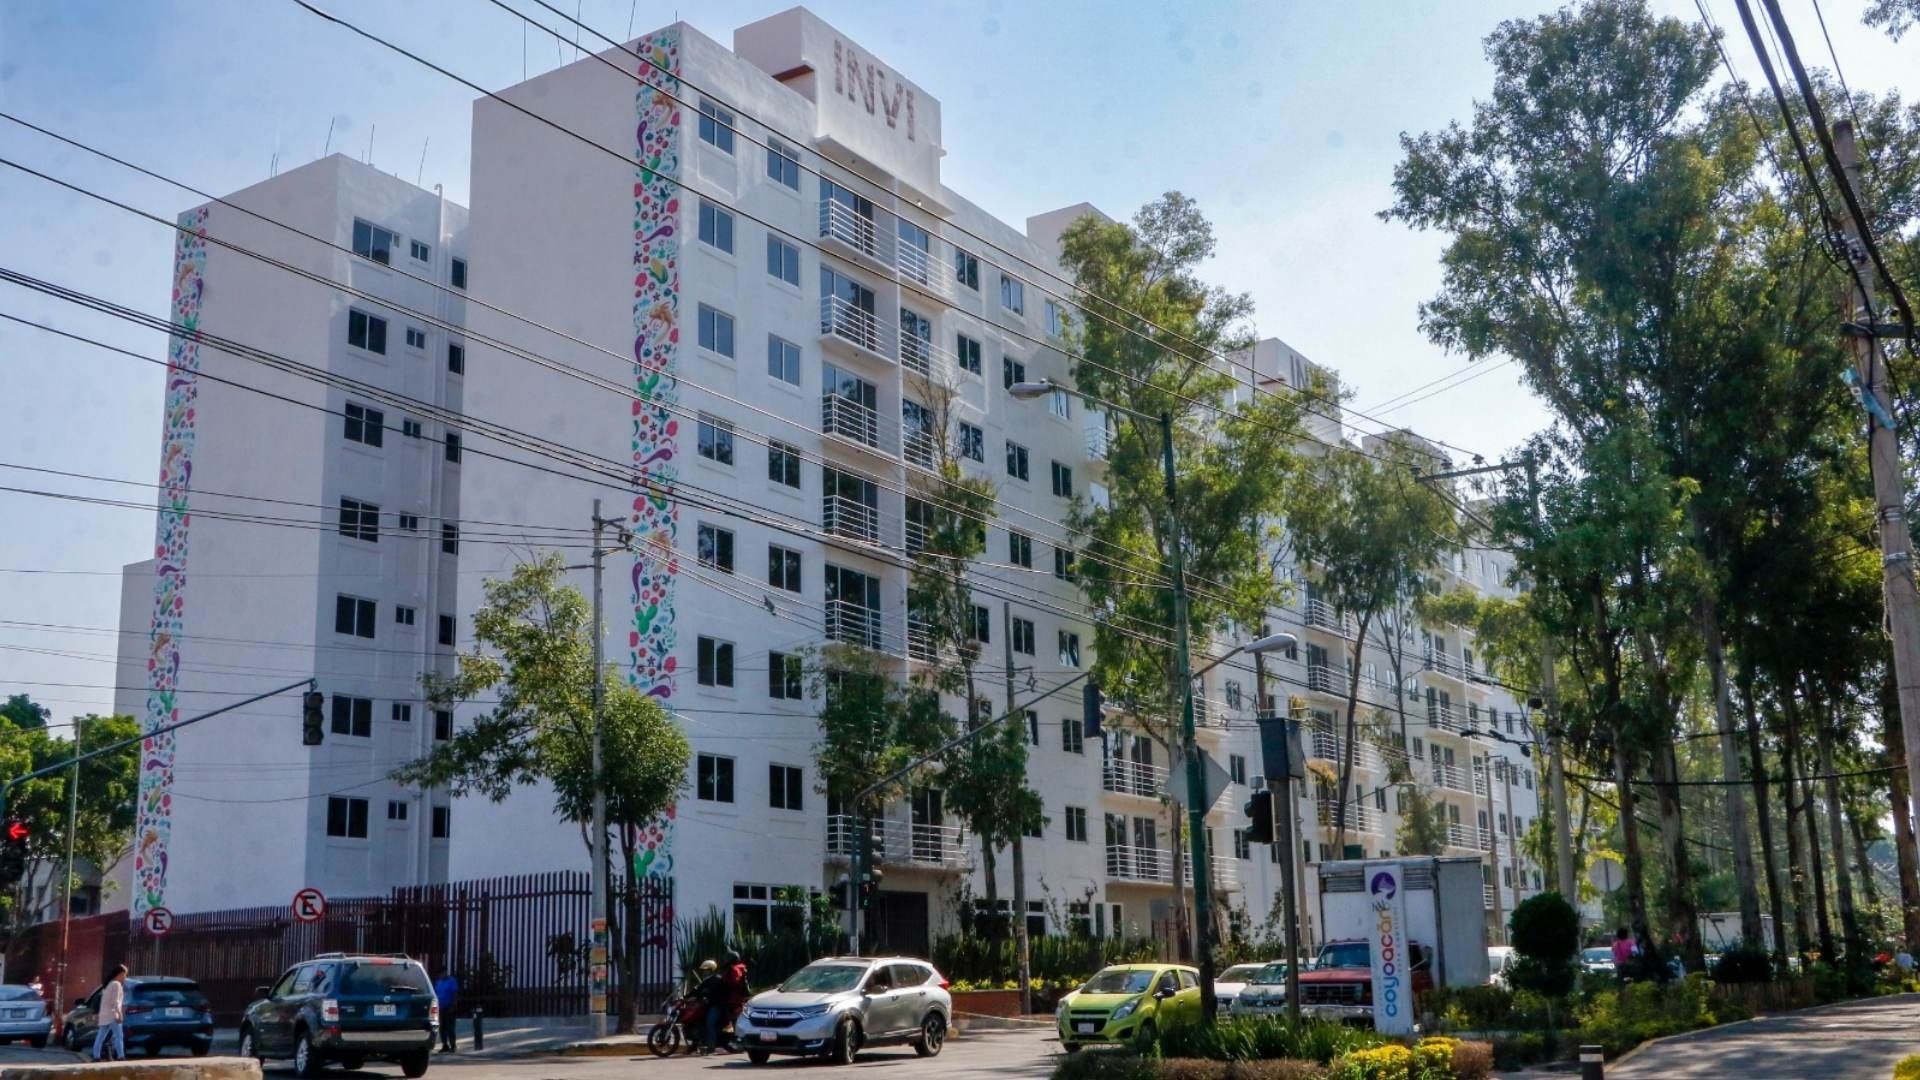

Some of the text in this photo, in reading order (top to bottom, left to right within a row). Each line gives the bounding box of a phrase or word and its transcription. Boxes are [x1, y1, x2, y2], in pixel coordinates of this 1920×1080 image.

[833, 39, 915, 142] INVI
[302, 895, 316, 916] E
[153, 912, 166, 930] E
